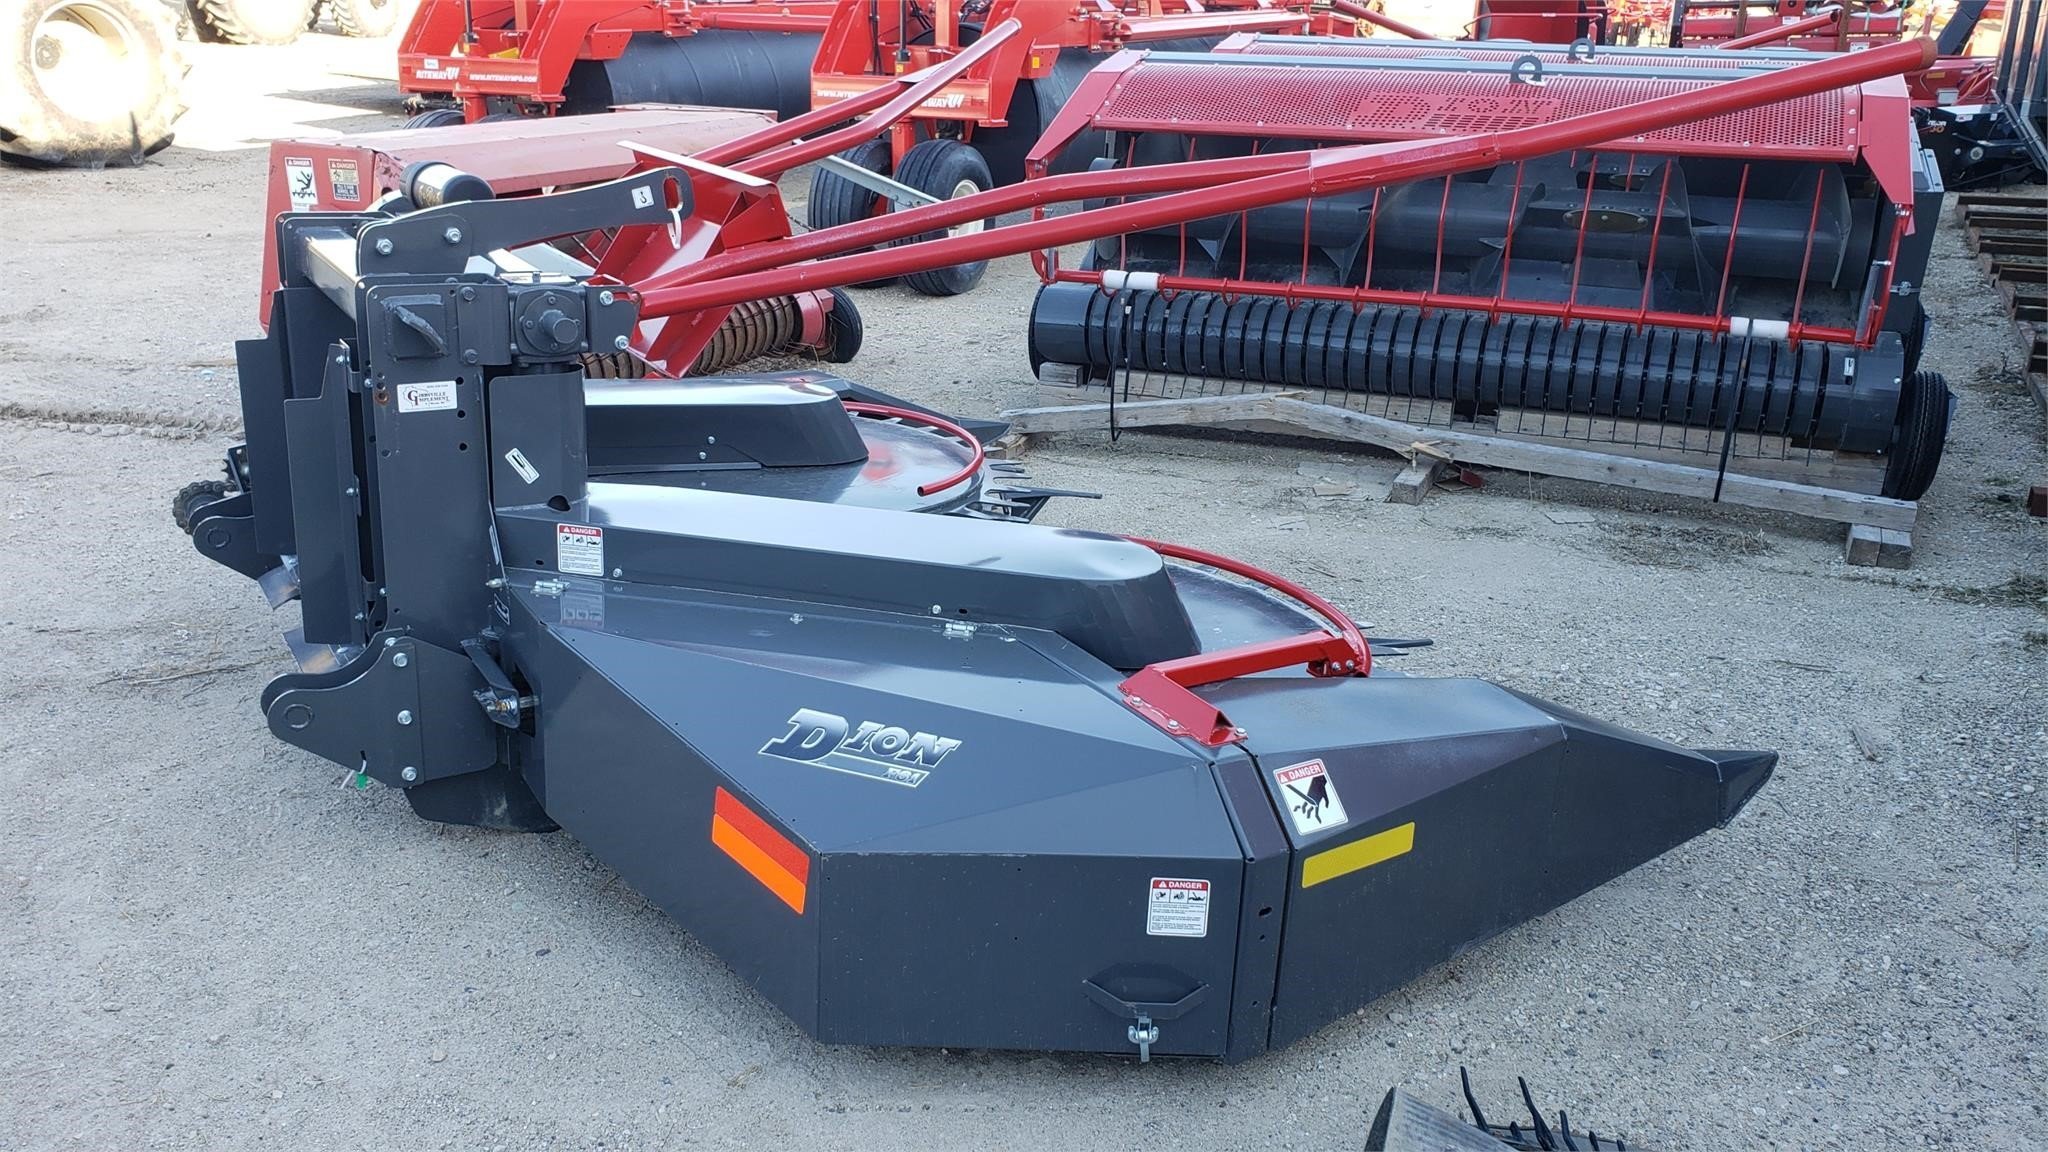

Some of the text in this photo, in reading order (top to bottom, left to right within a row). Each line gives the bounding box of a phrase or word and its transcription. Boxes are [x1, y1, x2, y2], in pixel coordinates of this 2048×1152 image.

[571, 527, 597, 535] DANGER
[758, 708, 963, 768] DION
[1288, 764, 1321, 780] DANGER
[1168, 881, 1202, 889] DANGER
